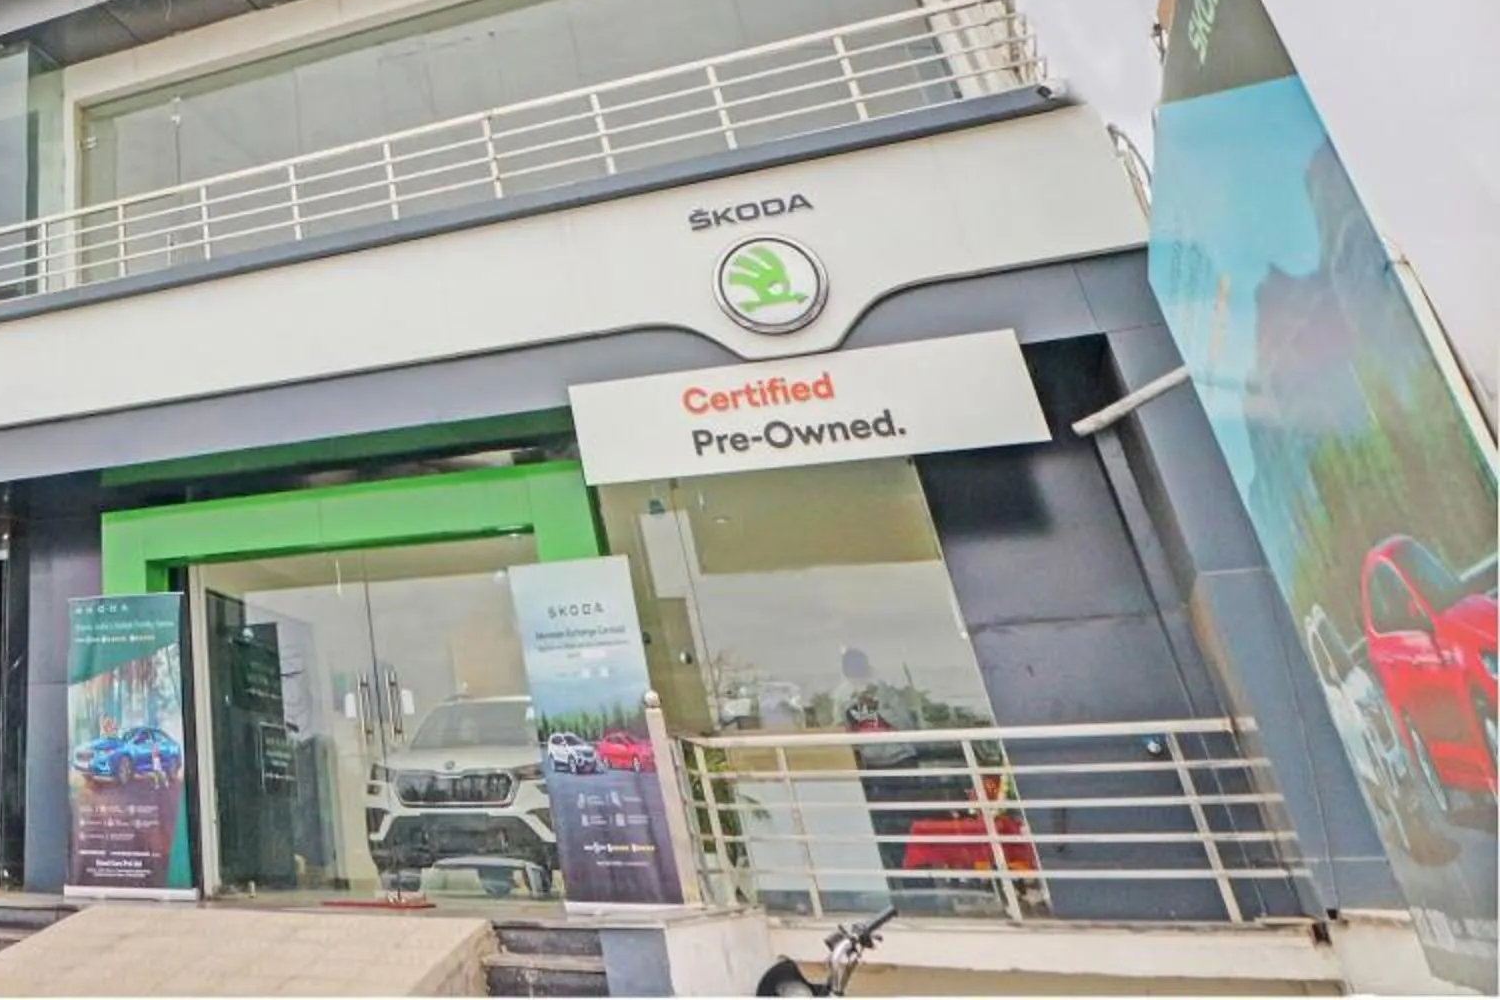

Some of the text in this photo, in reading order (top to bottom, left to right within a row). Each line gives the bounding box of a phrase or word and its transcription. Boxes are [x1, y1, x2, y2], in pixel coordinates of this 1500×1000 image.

[688, 193, 814, 232] ŠKODA
[681, 371, 836, 416] Certified
[692, 409, 908, 457] Pre-Owned.
